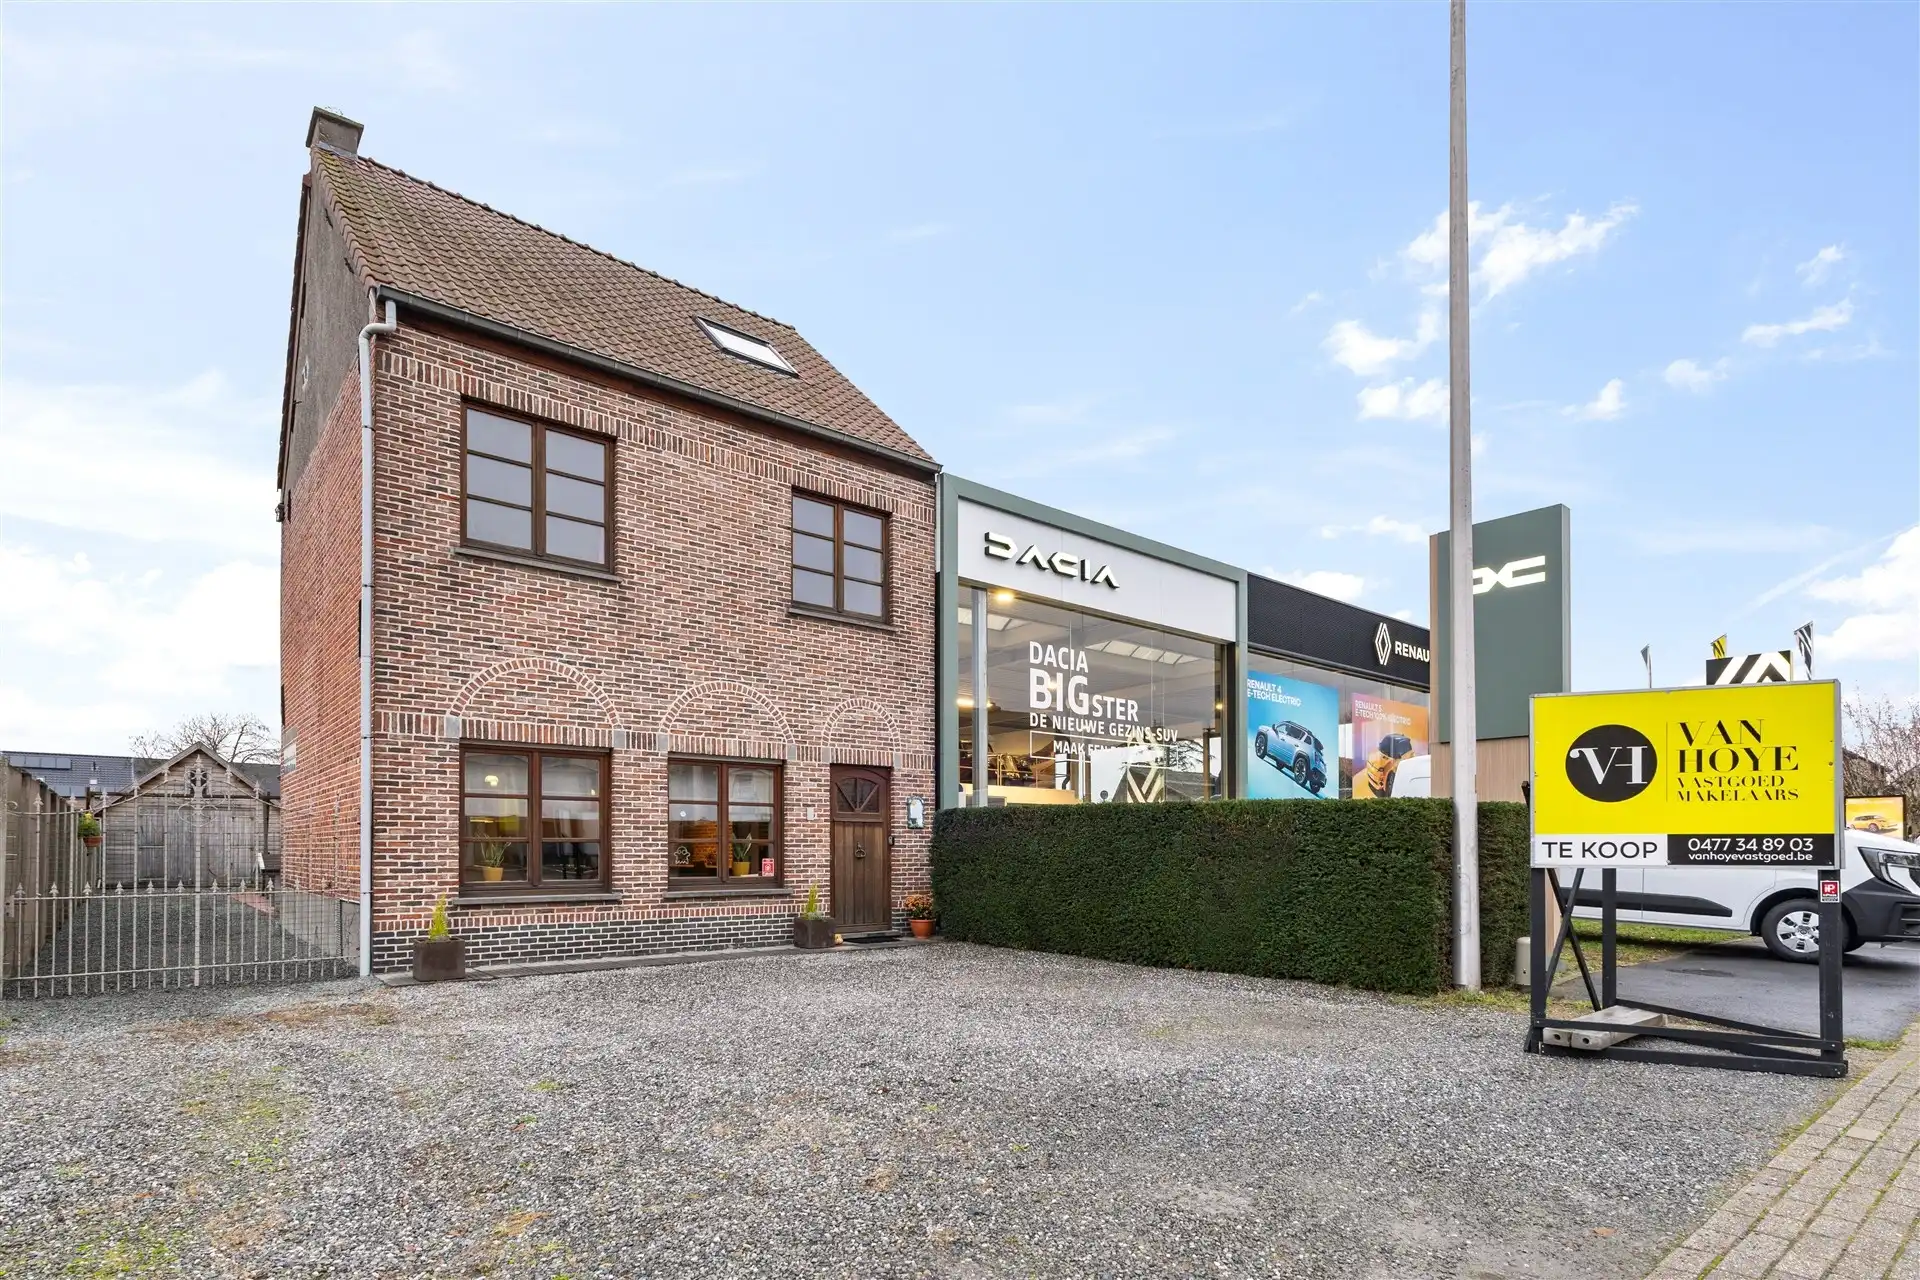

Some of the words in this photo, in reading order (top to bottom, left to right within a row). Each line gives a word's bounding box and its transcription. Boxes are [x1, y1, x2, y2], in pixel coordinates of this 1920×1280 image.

[985, 531, 1120, 590] DACIA
[1029, 641, 1089, 673] DACIA
[1394, 640, 1430, 663] RENAU
[1247, 679, 1277, 692] RENAULT
[1029, 667, 1139, 722] BIGSTER
[1247, 689, 1271, 701] E-TECH
[1029, 712, 1047, 728] DE
[1052, 715, 1105, 735] NIEUWE
[1109, 722, 1178, 742] GEZINS-SUV
[1678, 719, 1764, 747] VAN
[1053, 740, 1086, 755] MAAK
[1676, 746, 1798, 773] HOYE
[1677, 775, 1785, 788] VASTGOED
[1677, 789, 1799, 802] MAKELAARS
[1542, 842, 1573, 858] TE
[1582, 842, 1658, 858] KOOP
[1688, 838, 1731, 850] 0477
[1736, 838, 1758, 850] 34
[1763, 838, 1785, 850] 89
[1790, 838, 1813, 850] 03
[1689, 851, 1813, 862] vanhoyevastgoed.be
